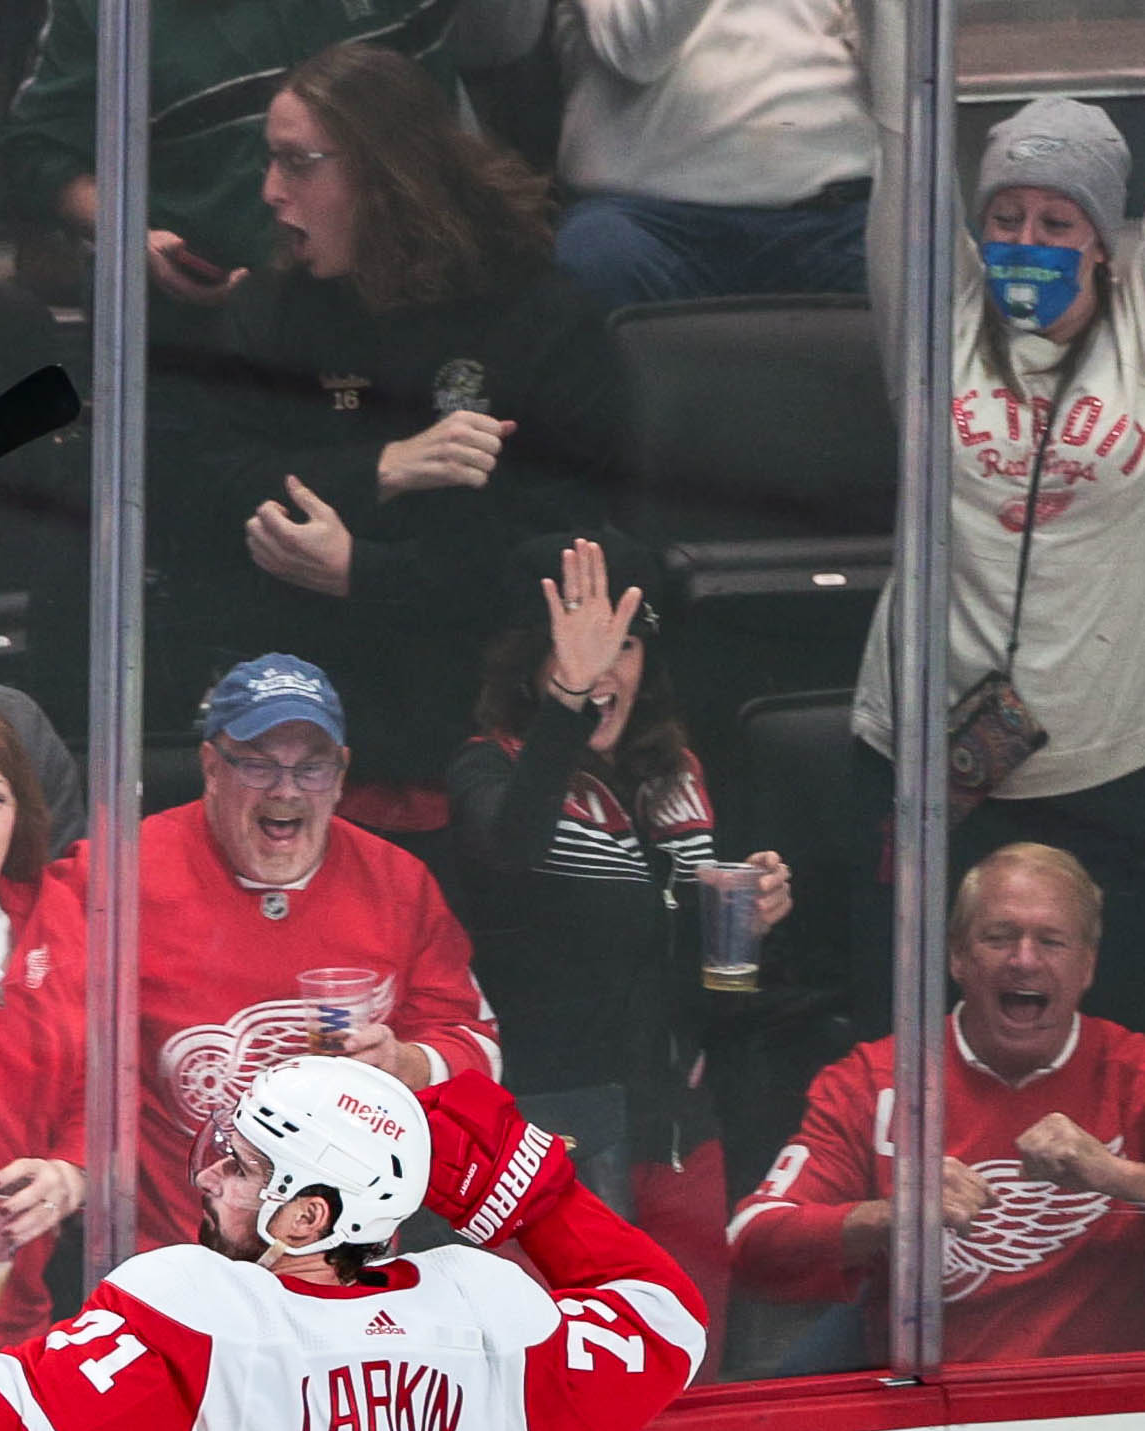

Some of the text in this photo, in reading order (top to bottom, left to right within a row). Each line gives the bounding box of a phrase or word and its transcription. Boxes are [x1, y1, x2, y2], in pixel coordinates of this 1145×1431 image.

[336, 1092, 406, 1142] meijer
[459, 1161, 478, 1198] COVERT
[364, 1325, 407, 1336] adidas
